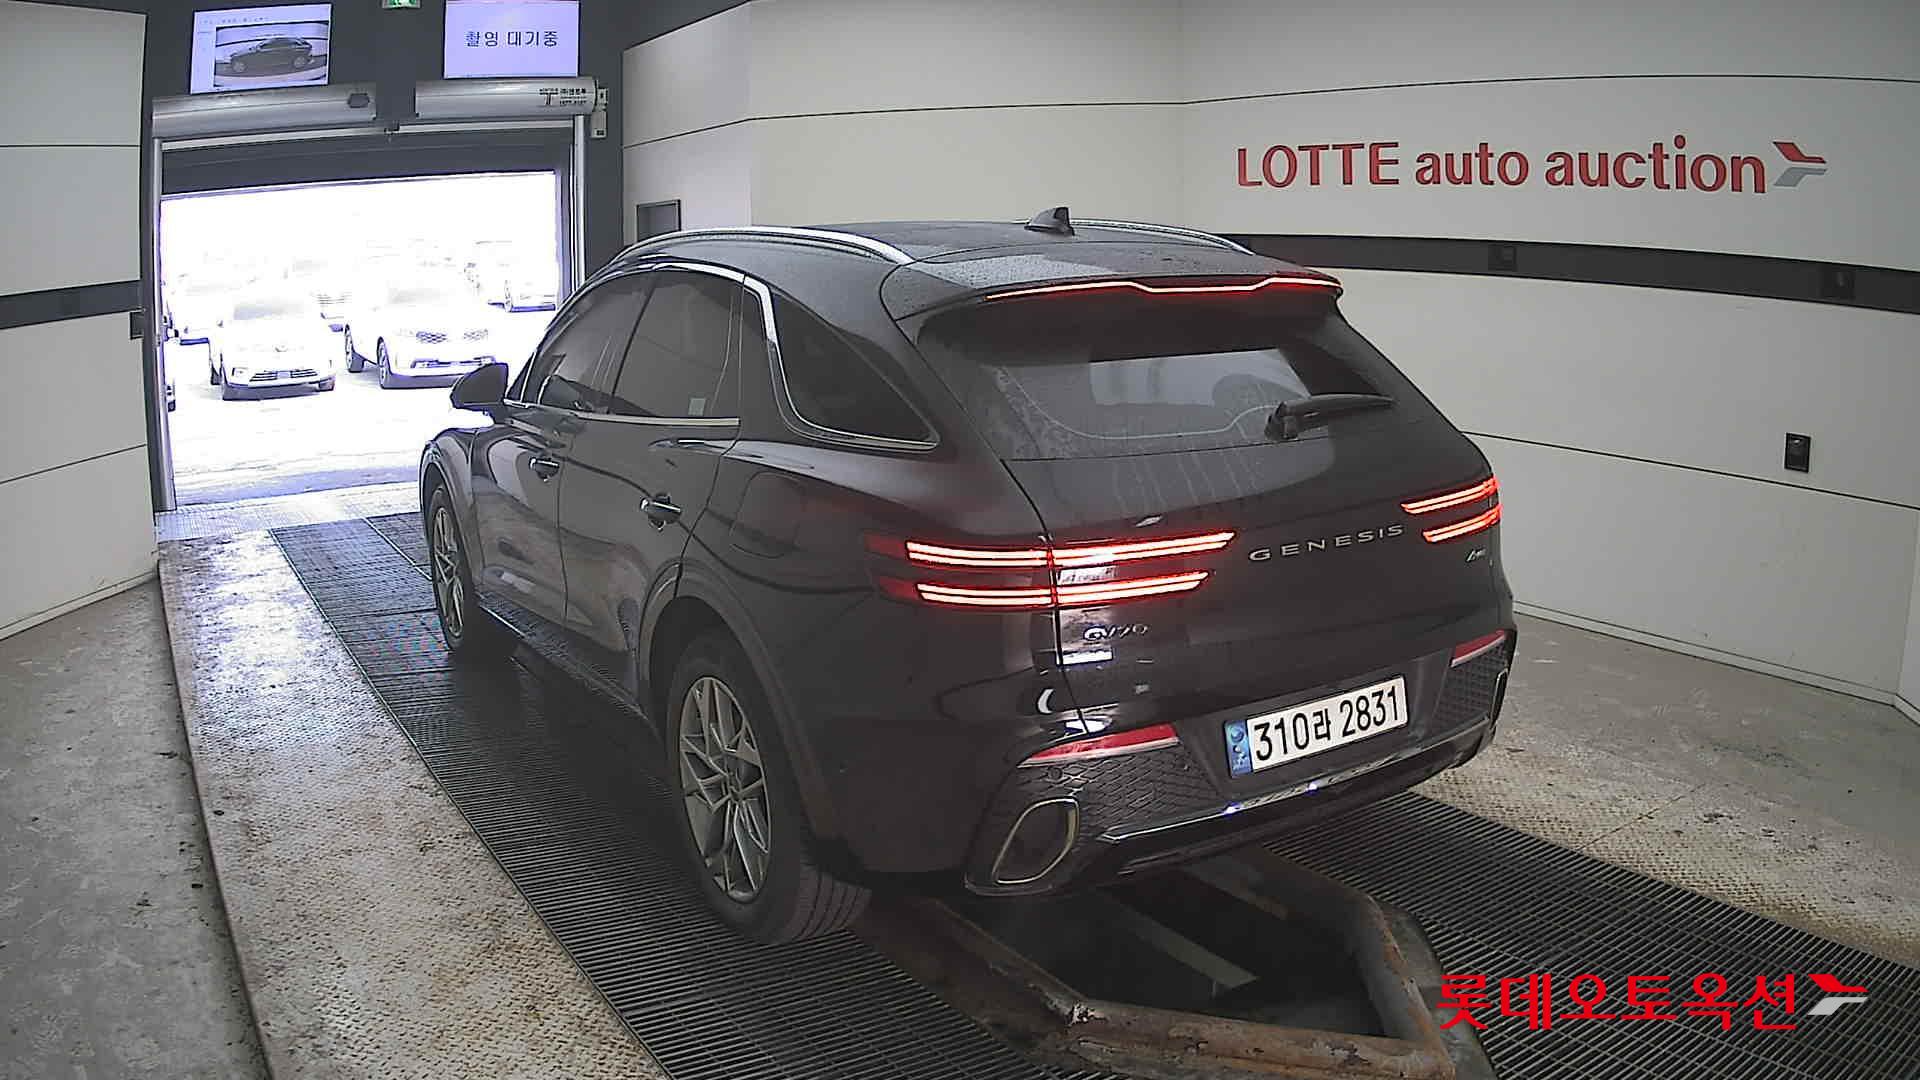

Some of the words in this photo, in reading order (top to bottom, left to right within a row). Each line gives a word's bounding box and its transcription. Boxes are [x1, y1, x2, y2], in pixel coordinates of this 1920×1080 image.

[507, 31, 558, 47] 대기중
[1237, 142, 1399, 188] LOTTE
[1415, 143, 1530, 186] auto
[1545, 134, 1767, 193] auction
[1249, 524, 1404, 561] GENESIS
[1254, 709, 1331, 761] 310라
[1340, 686, 1399, 737] 2831
